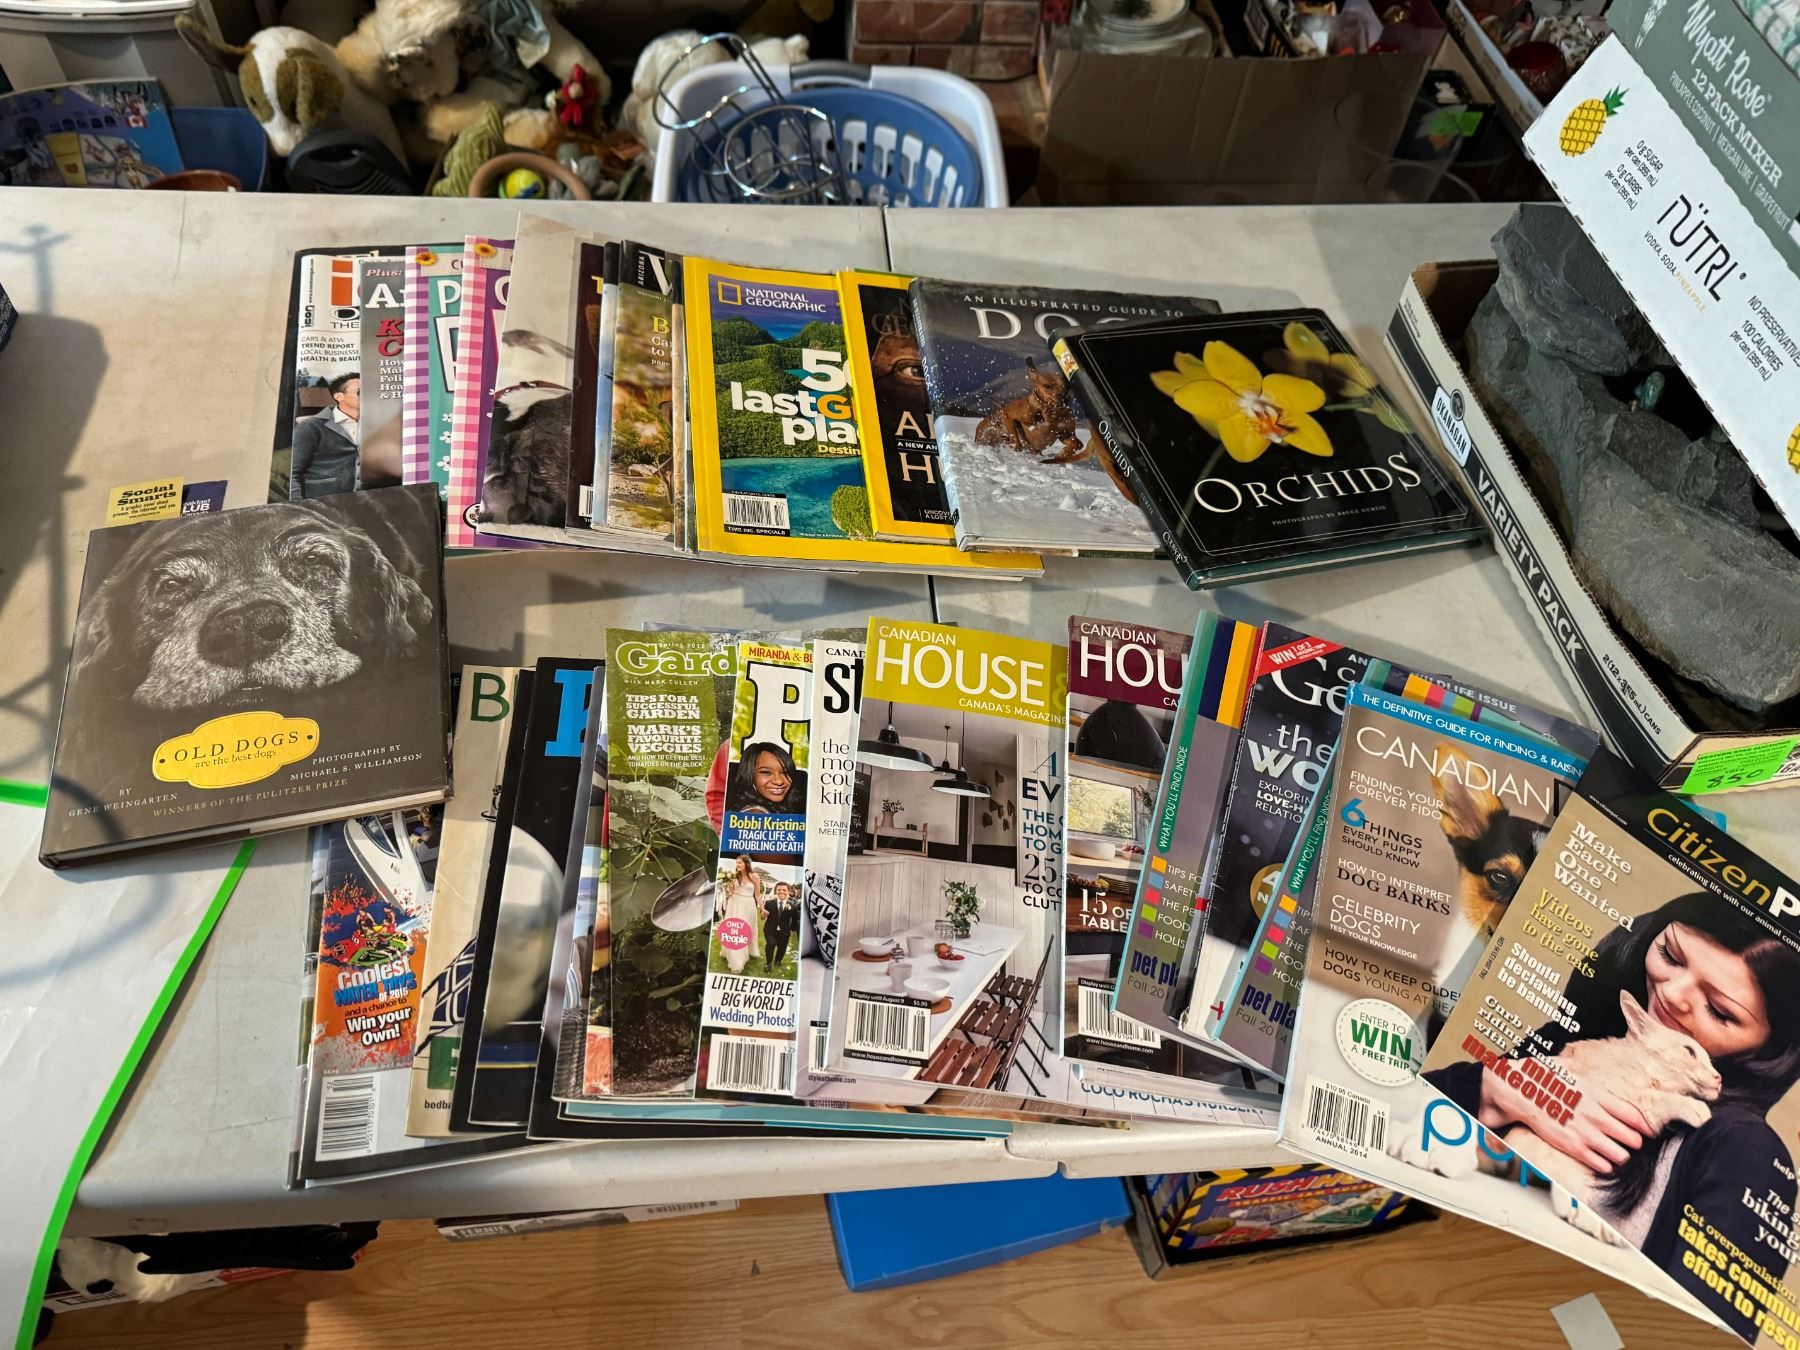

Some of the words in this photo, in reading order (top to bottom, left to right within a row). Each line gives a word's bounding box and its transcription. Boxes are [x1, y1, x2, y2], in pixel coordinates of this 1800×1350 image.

[1683, 1, 1734, 72] Wyatt
[1724, 50, 1765, 118] Rose
[1692, 68, 1707, 92] 12
[1704, 82, 1740, 132] PACK
[1735, 122, 1783, 189] MIXER
[1644, 149, 1663, 173] SUGAR
[1624, 173, 1642, 195] CARBS
[365, 269, 402, 277] Plus:
[745, 287, 809, 302] NATIONAL
[745, 297, 826, 313] GEOGRAPHIC
[992, 297, 1101, 312] ILLUSTRATED
[1109, 305, 1158, 316] GUIDE
[1164, 310, 1184, 318] TO
[1752, 333, 1783, 371] CALORIES
[1435, 397, 1468, 456] OKANAGAN
[1099, 420, 1134, 478] ORCHIDS
[122, 484, 174, 498] Social
[1194, 451, 1421, 513] ORCHIDS
[117, 491, 176, 506] Smarts
[1272, 514, 1324, 526] PHOTOGRAPHY
[1337, 509, 1360, 517] BRUCE
[1361, 505, 1387, 514] CURTIS
[1477, 467, 1541, 579] VARIETY
[1537, 580, 1584, 663] PACK
[879, 625, 956, 646] CANADIAN
[1080, 622, 1156, 646] CANADIAN
[748, 647, 791, 661] MIRANDA
[1268, 649, 1297, 665] WIN
[875, 639, 1045, 707] HOUSE
[626, 694, 656, 702] TIPS
[659, 694, 687, 702] FOR
[690, 695, 699, 703] A
[626, 702, 699, 710] SUCCESSFUL
[959, 698, 1012, 714] CANADA'S
[1479, 690, 1518, 714] ISSUE
[626, 709, 700, 719] GARDEN
[1362, 693, 1381, 706] THE
[1382, 699, 1433, 725] DEFINITIVE
[1435, 715, 1468, 735] GUIDE
[1469, 726, 1492, 744] FOR
[1494, 736, 1538, 760] FINDING
[627, 724, 701, 735] MARK'S
[628, 735, 701, 743] FAVOURITE
[174, 743, 225, 762] OLD
[236, 731, 300, 753] DOGS
[195, 758, 211, 769] are
[213, 755, 229, 766] the
[232, 751, 252, 764] best
[254, 749, 277, 761] dogs
[312, 746, 386, 765] PHOTOGRAPHS
[389, 744, 402, 753] BY
[628, 742, 702, 753] VEGGIES
[822, 739, 850, 754] the
[290, 768, 338, 781] MICHAEL
[354, 752, 423, 771] WILLIAMSON
[1356, 726, 1551, 815] CANADIAN
[153, 802, 207, 818] WINNERS
[210, 799, 226, 808] OF
[229, 795, 252, 805] THE
[256, 785, 312, 801] PULITZER
[315, 778, 349, 792] PRIZE
[1159, 822, 1173, 848] WHAT
[1175, 746, 1188, 770] INSIDE
[1349, 781, 1407, 810] FOREVER
[1412, 803, 1443, 821] FIDO
[1351, 770, 1403, 797] FINDING
[1407, 787, 1444, 810] YOUR
[69, 805, 99, 818] GENE
[103, 793, 178, 811] WEINGARTEN
[730, 815, 761, 830] Bobbi
[764, 817, 806, 831] Kristina
[738, 830, 767, 840] TRAGIC
[768, 831, 785, 840] LIFE
[1362, 819, 1423, 849] THINGS
[729, 839, 775, 851] TROUBLING
[777, 842, 804, 852] DEATH
[1341, 836, 1383, 857] SHOULD
[1385, 852, 1420, 869] KNOW
[1343, 825, 1378, 846] EVERY
[1383, 839, 1421, 859] PUPPY
[1573, 821, 1632, 875] Make
[1168, 865, 1186, 879] TIPS
[1558, 850, 1603, 890] One
[1564, 835, 1618, 885] Each
[1080, 889, 1108, 915] 15
[1337, 867, 1379, 894] DOG
[1386, 884, 1451, 916] BARKS
[1389, 876, 1452, 903] INTERPRET
[1553, 862, 1636, 933] Wanted
[1668, 854, 1708, 886] celebrating
[1710, 881, 1722, 895] life
[1723, 892, 1739, 907] with
[1740, 905, 1755, 918] our
[1755, 915, 1781, 937] animal
[726, 921, 744, 929] ONLY
[1330, 908, 1382, 938] DOGS
[1332, 894, 1421, 935] CELEBRITY
[1538, 888, 1593, 939] Videos
[721, 933, 748, 945] People
[1528, 907, 1564, 936] have
[1565, 931, 1599, 962] gone
[1325, 947, 1360, 969] HOW
[1362, 961, 1379, 974] TO
[1384, 966, 1418, 987] KEEP
[1511, 942, 1562, 984] Should
[1540, 931, 1564, 955] the
[1566, 953, 1596, 979] cats
[336, 954, 412, 991] Coolest
[1323, 960, 1361, 983] DOGS
[1365, 973, 1409, 1001] YOUNG
[333, 981, 379, 1008] WATER
[379, 992, 389, 1002] OF
[390, 987, 409, 1001] 2015
[712, 976, 747, 992] LITTLE
[750, 980, 795, 997] PEOPLE,
[1503, 956, 1579, 1017] declawing
[721, 993, 743, 1007] BIG
[744, 996, 784, 1011] WORLD
[1516, 979, 1581, 1035] banned?
[345, 1016, 377, 1033] Win
[377, 1006, 412, 1028] your
[710, 1007, 754, 1026] Wedding
[757, 1011, 795, 1027] Photos!
[1360, 1012, 1390, 1030] ENTER
[1392, 1024, 1407, 1035] TO
[1484, 995, 1525, 1030] Curb
[1525, 1025, 1554, 1051] bad
[360, 1023, 402, 1047] Own!
[1351, 1018, 1412, 1062] WIN
[1477, 1007, 1526, 1048] riding
[1526, 1043, 1577, 1086] habits
[851, 1051, 921, 1065] www.houseandhome.com
[1361, 1049, 1385, 1064] FREE
[1388, 1057, 1410, 1071] TRIP
[808, 1075, 856, 1084] styleathome.com
[1461, 1033, 1575, 1129] makeover
[1520, 1056, 1583, 1112] mind
[1315, 1135, 1348, 1153] ANNUAL
[1350, 1146, 1368, 1159] 2014
[1766, 1189, 1790, 1215] The
[1678, 1218, 1729, 1271] takes
[1683, 1204, 1705, 1227] Cat
[1706, 1224, 1796, 1304] overpopulation
[1683, 1250, 1734, 1303] effort
